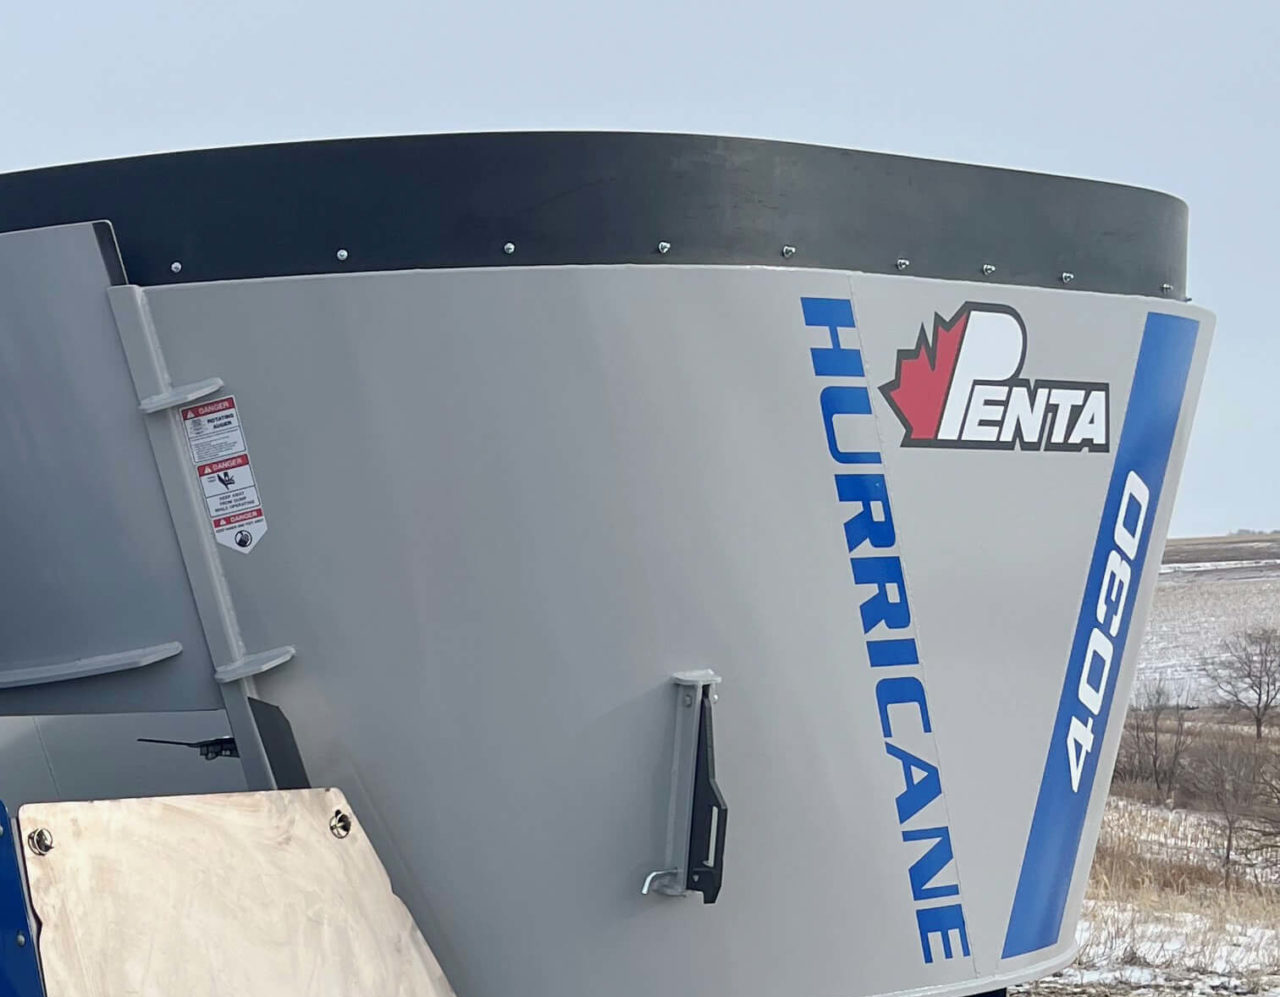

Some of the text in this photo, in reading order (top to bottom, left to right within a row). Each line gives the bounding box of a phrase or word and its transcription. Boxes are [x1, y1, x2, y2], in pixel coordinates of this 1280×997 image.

[198, 401, 230, 415] DANGER
[936, 305, 1109, 448] PENTA
[212, 457, 243, 471] DANGER
[230, 511, 258, 523] DANGER
[800, 296, 971, 964] HURRICANE
[1065, 470, 1149, 793] 4030
